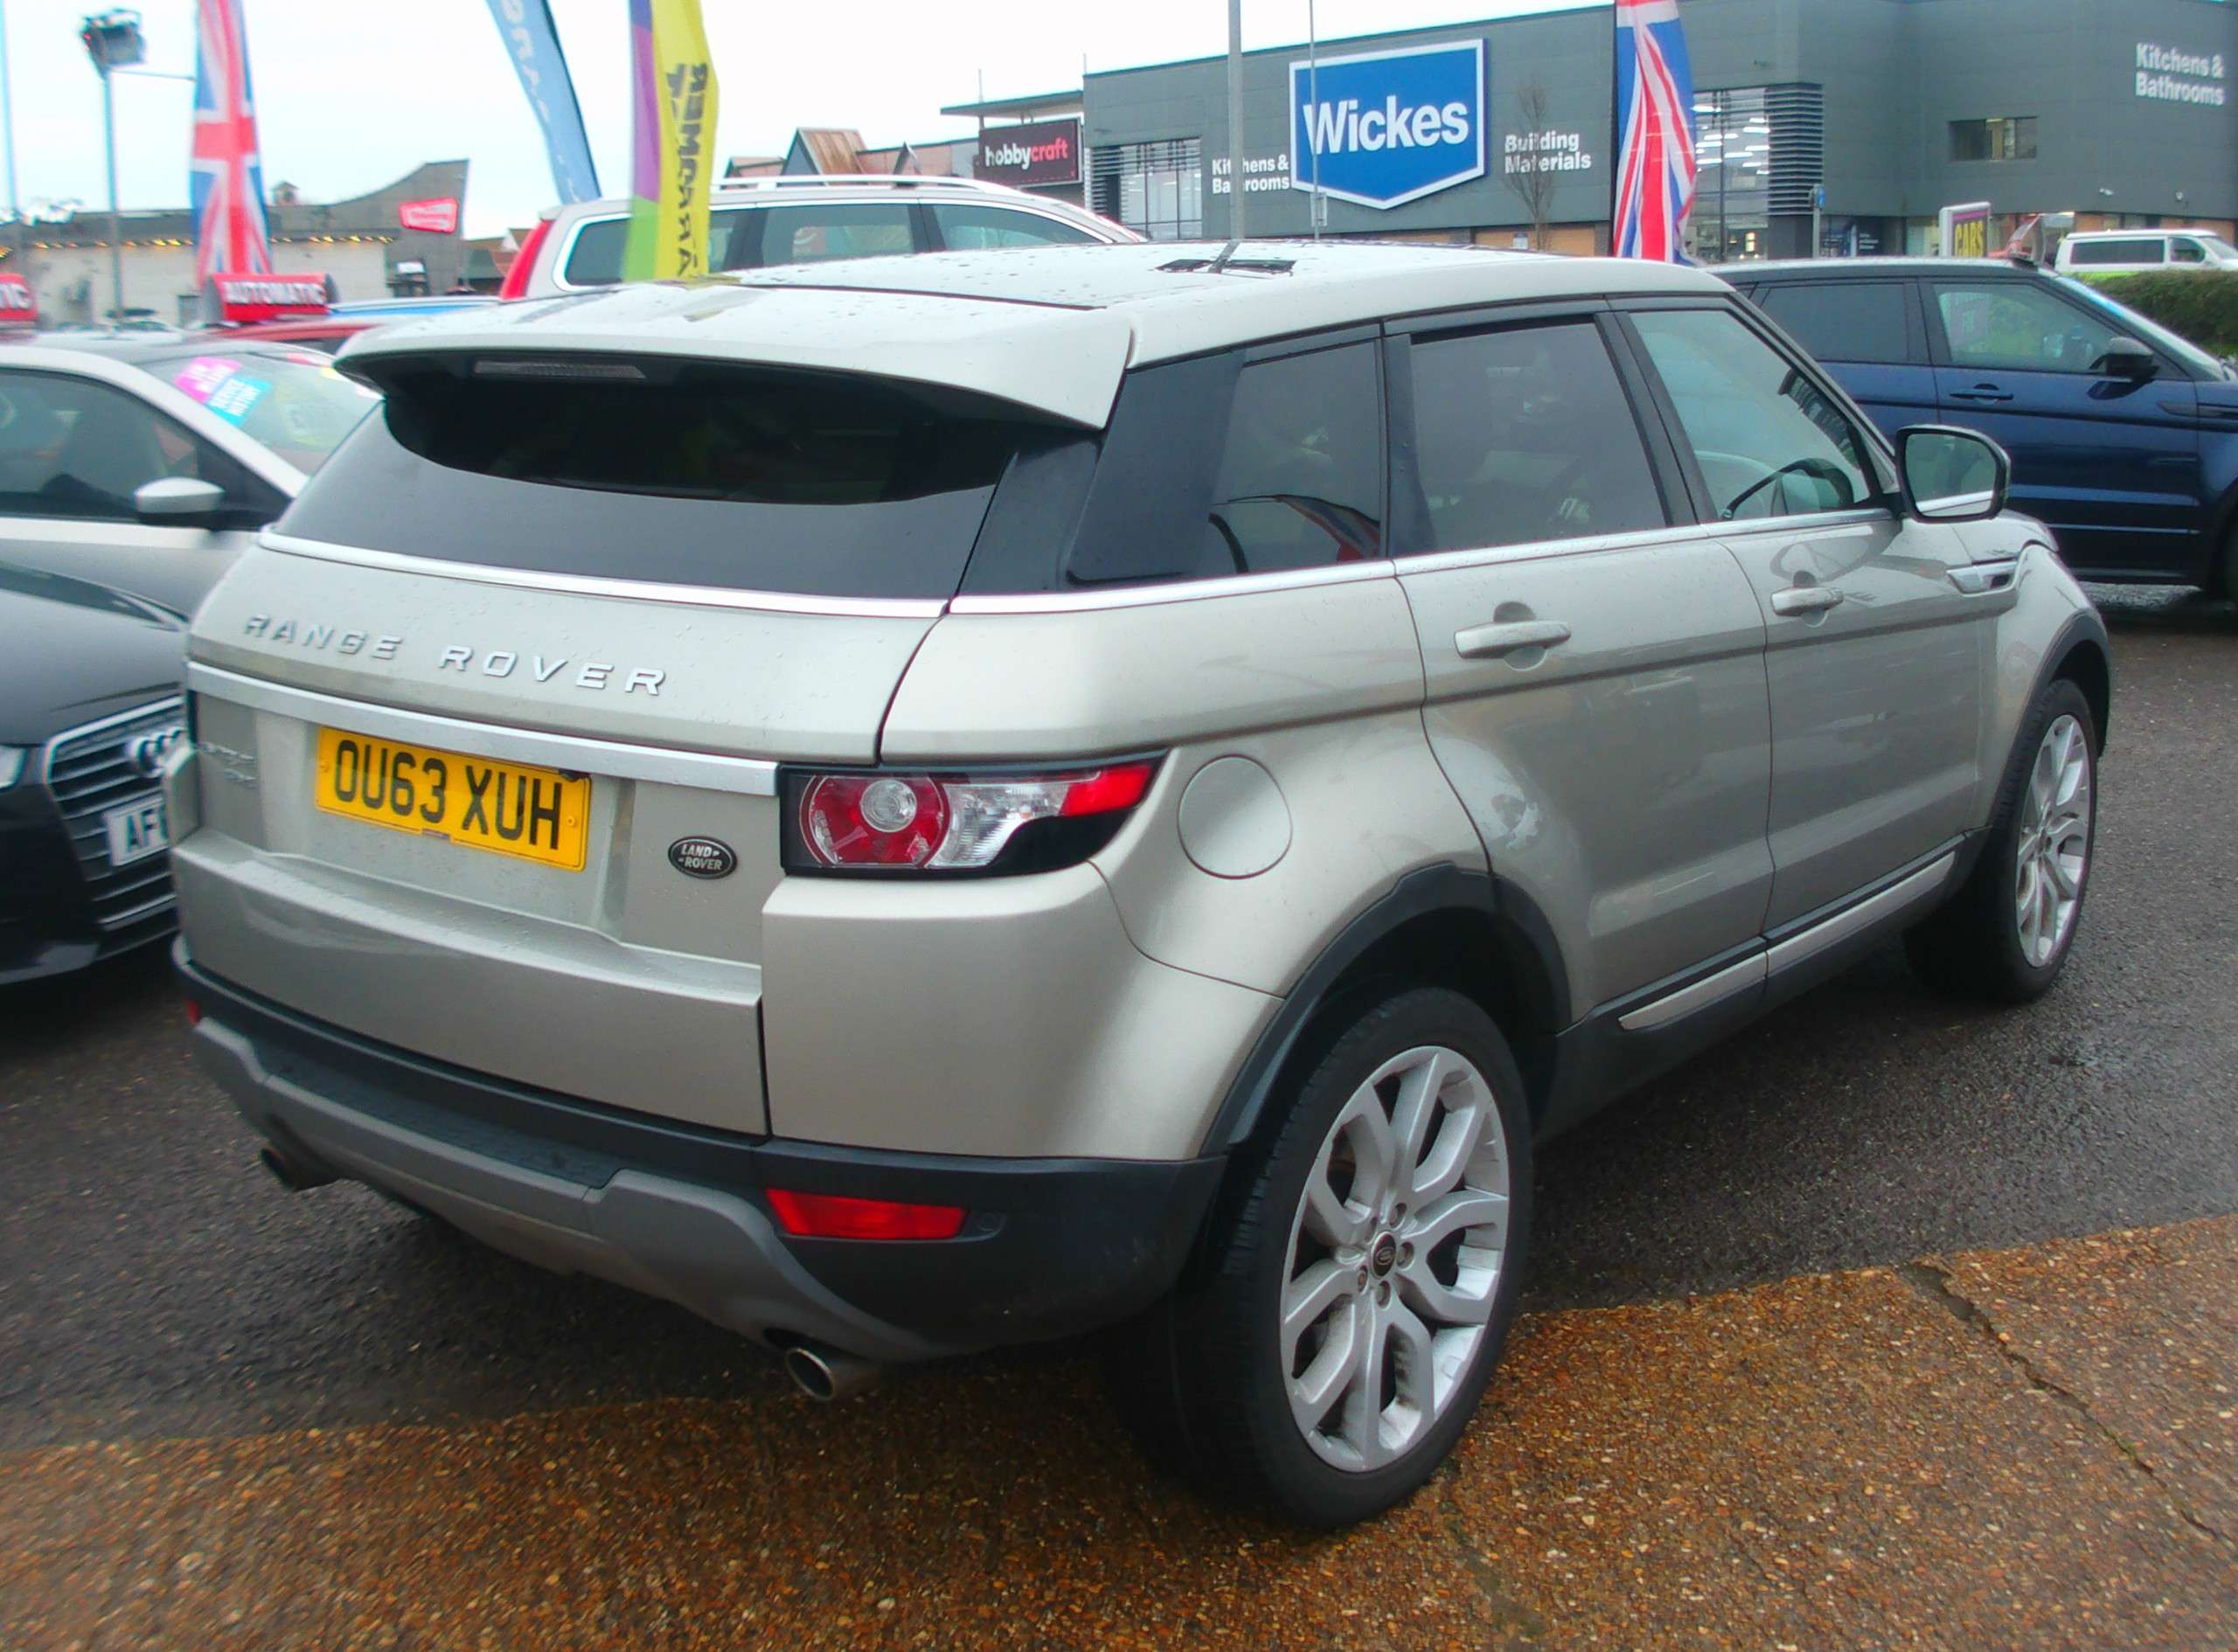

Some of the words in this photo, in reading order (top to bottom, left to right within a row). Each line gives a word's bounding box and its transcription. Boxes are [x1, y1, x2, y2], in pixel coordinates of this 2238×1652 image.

[2136, 42, 2209, 77] Kitchens
[2211, 54, 2224, 79] &
[2136, 71, 2224, 106] Bathrooms
[1303, 94, 1470, 155] Wickes
[1505, 130, 1580, 153] Building
[984, 136, 1068, 170] hobbycraft
[1212, 156, 1275, 176] Kithens
[1277, 153, 1289, 171] &
[1505, 151, 1592, 174] Materials
[1212, 177, 1289, 194] Barooms
[1955, 221, 1984, 257] CARS
[223, 281, 324, 304] AUTOMATIC
[243, 614, 404, 662] RANGE
[438, 644, 667, 696] ROVER
[335, 739, 448, 823] OU63
[462, 765, 563, 850] XUH
[125, 808, 168, 854] AF
